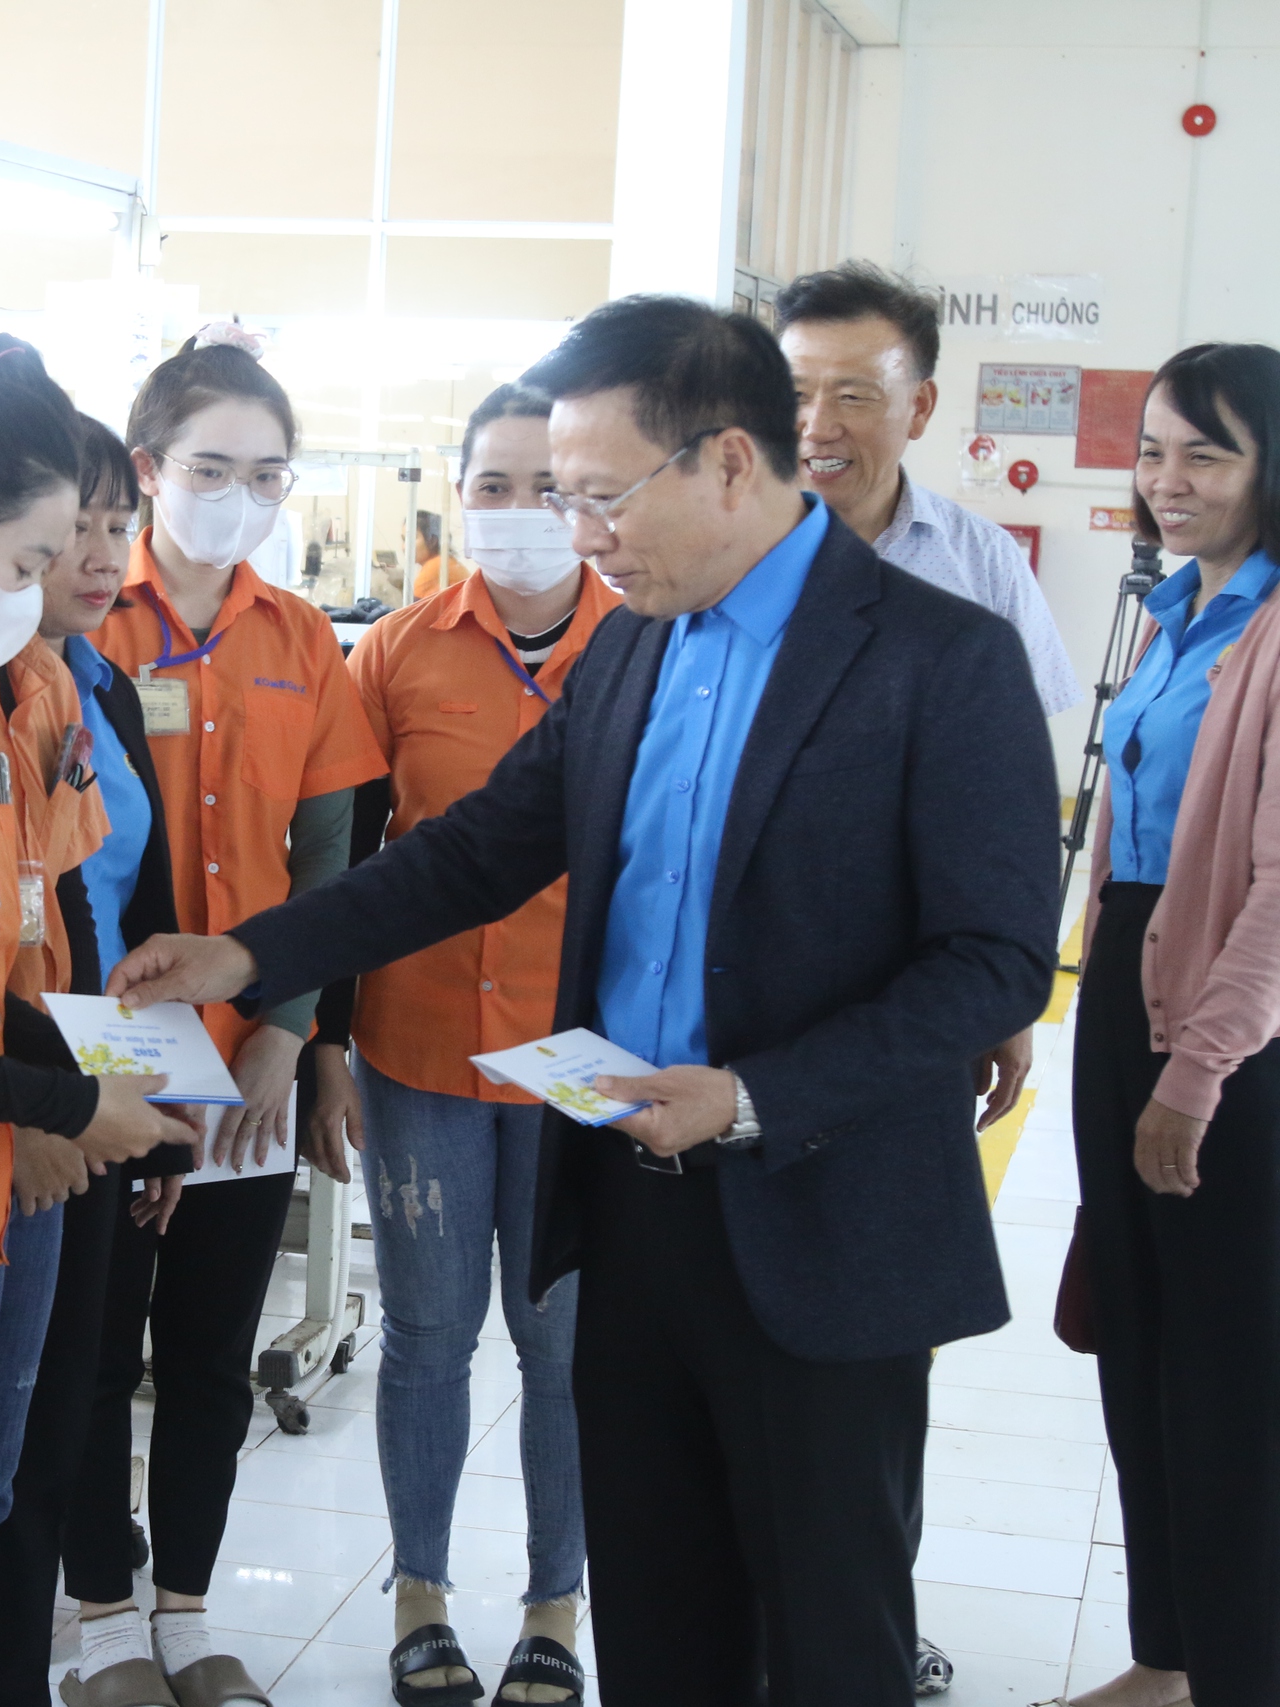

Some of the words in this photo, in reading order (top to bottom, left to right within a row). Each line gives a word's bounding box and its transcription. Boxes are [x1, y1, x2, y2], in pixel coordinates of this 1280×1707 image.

[939, 286, 998, 325] ÌNH
[1012, 297, 1099, 325] CHUÔNG
[391, 1646, 418, 1669] TEP
